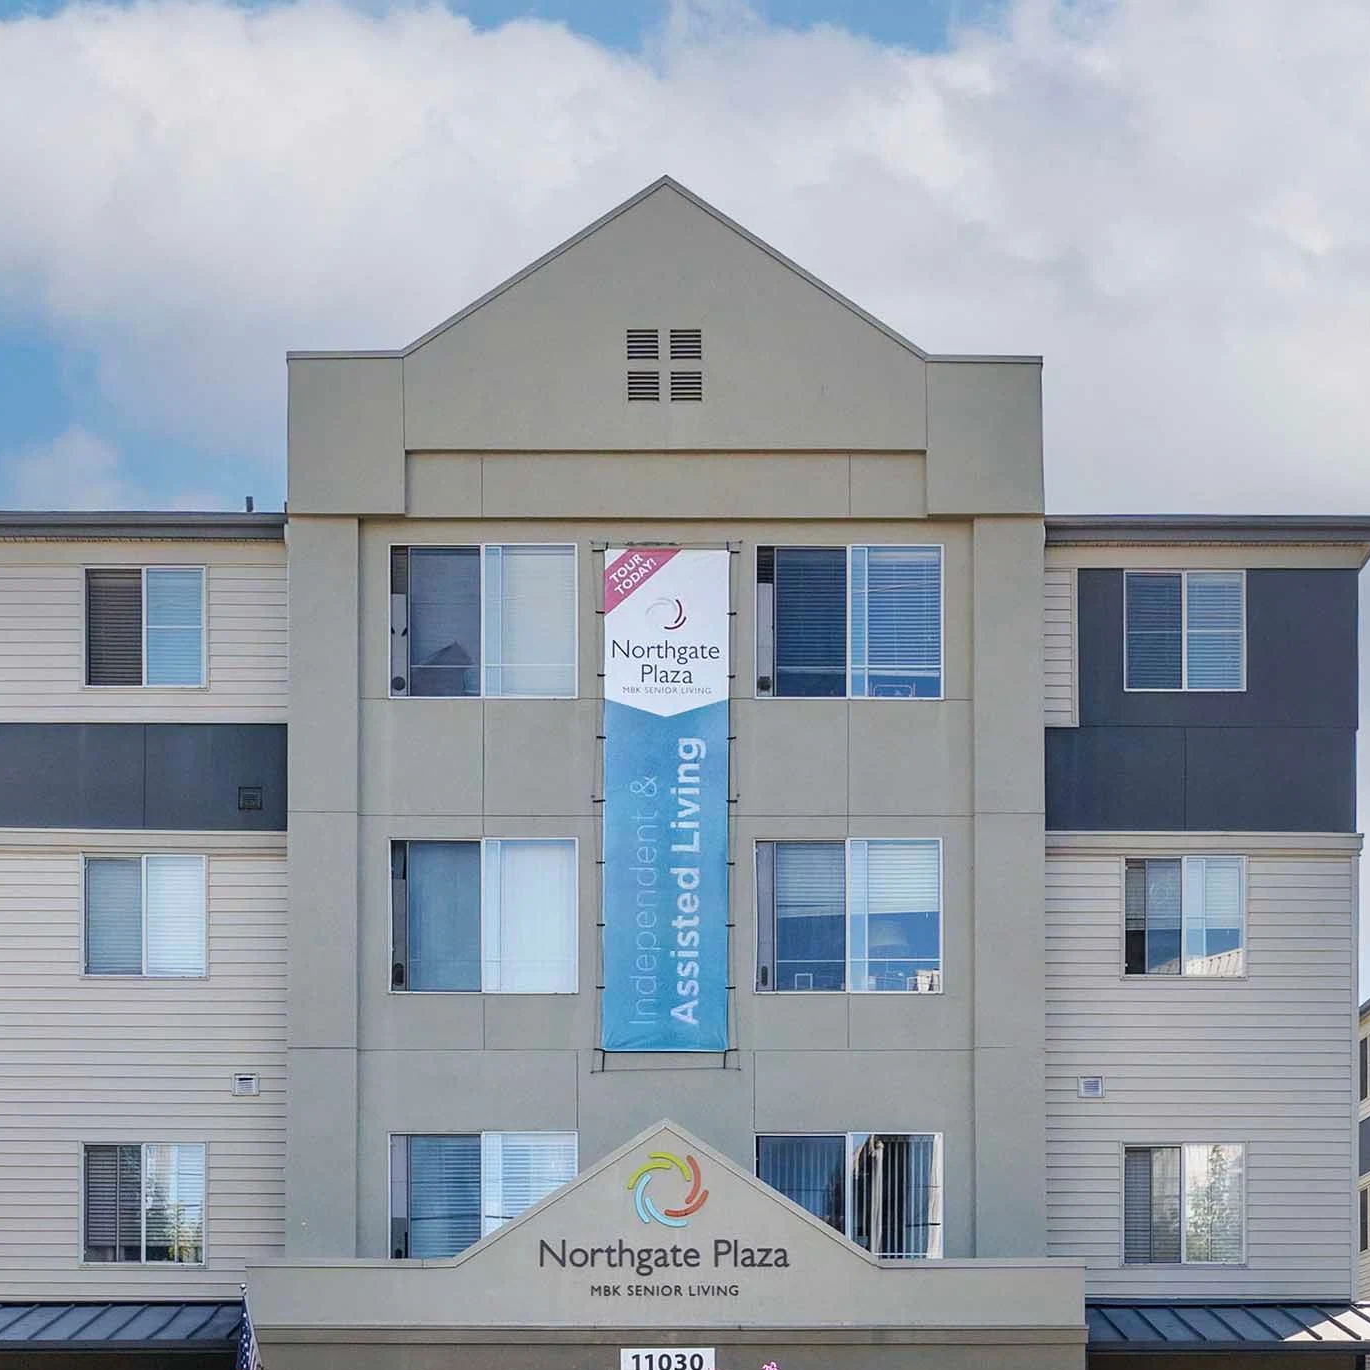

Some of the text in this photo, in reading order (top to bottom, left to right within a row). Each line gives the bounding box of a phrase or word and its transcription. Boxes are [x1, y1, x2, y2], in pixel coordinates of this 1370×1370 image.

[609, 553, 644, 583] TOUR
[614, 557, 657, 595] TODAY!
[612, 639, 720, 665] Northgate
[641, 664, 693, 684] Plaza
[622, 686, 712, 695] MBK SENIOR LIVING
[670, 738, 707, 1025] Assisted Living
[629, 776, 661, 1024] Independent &
[539, 1239, 790, 1276] Northgate Plaza
[590, 1284, 740, 1297] MBK SENIOR LIVING
